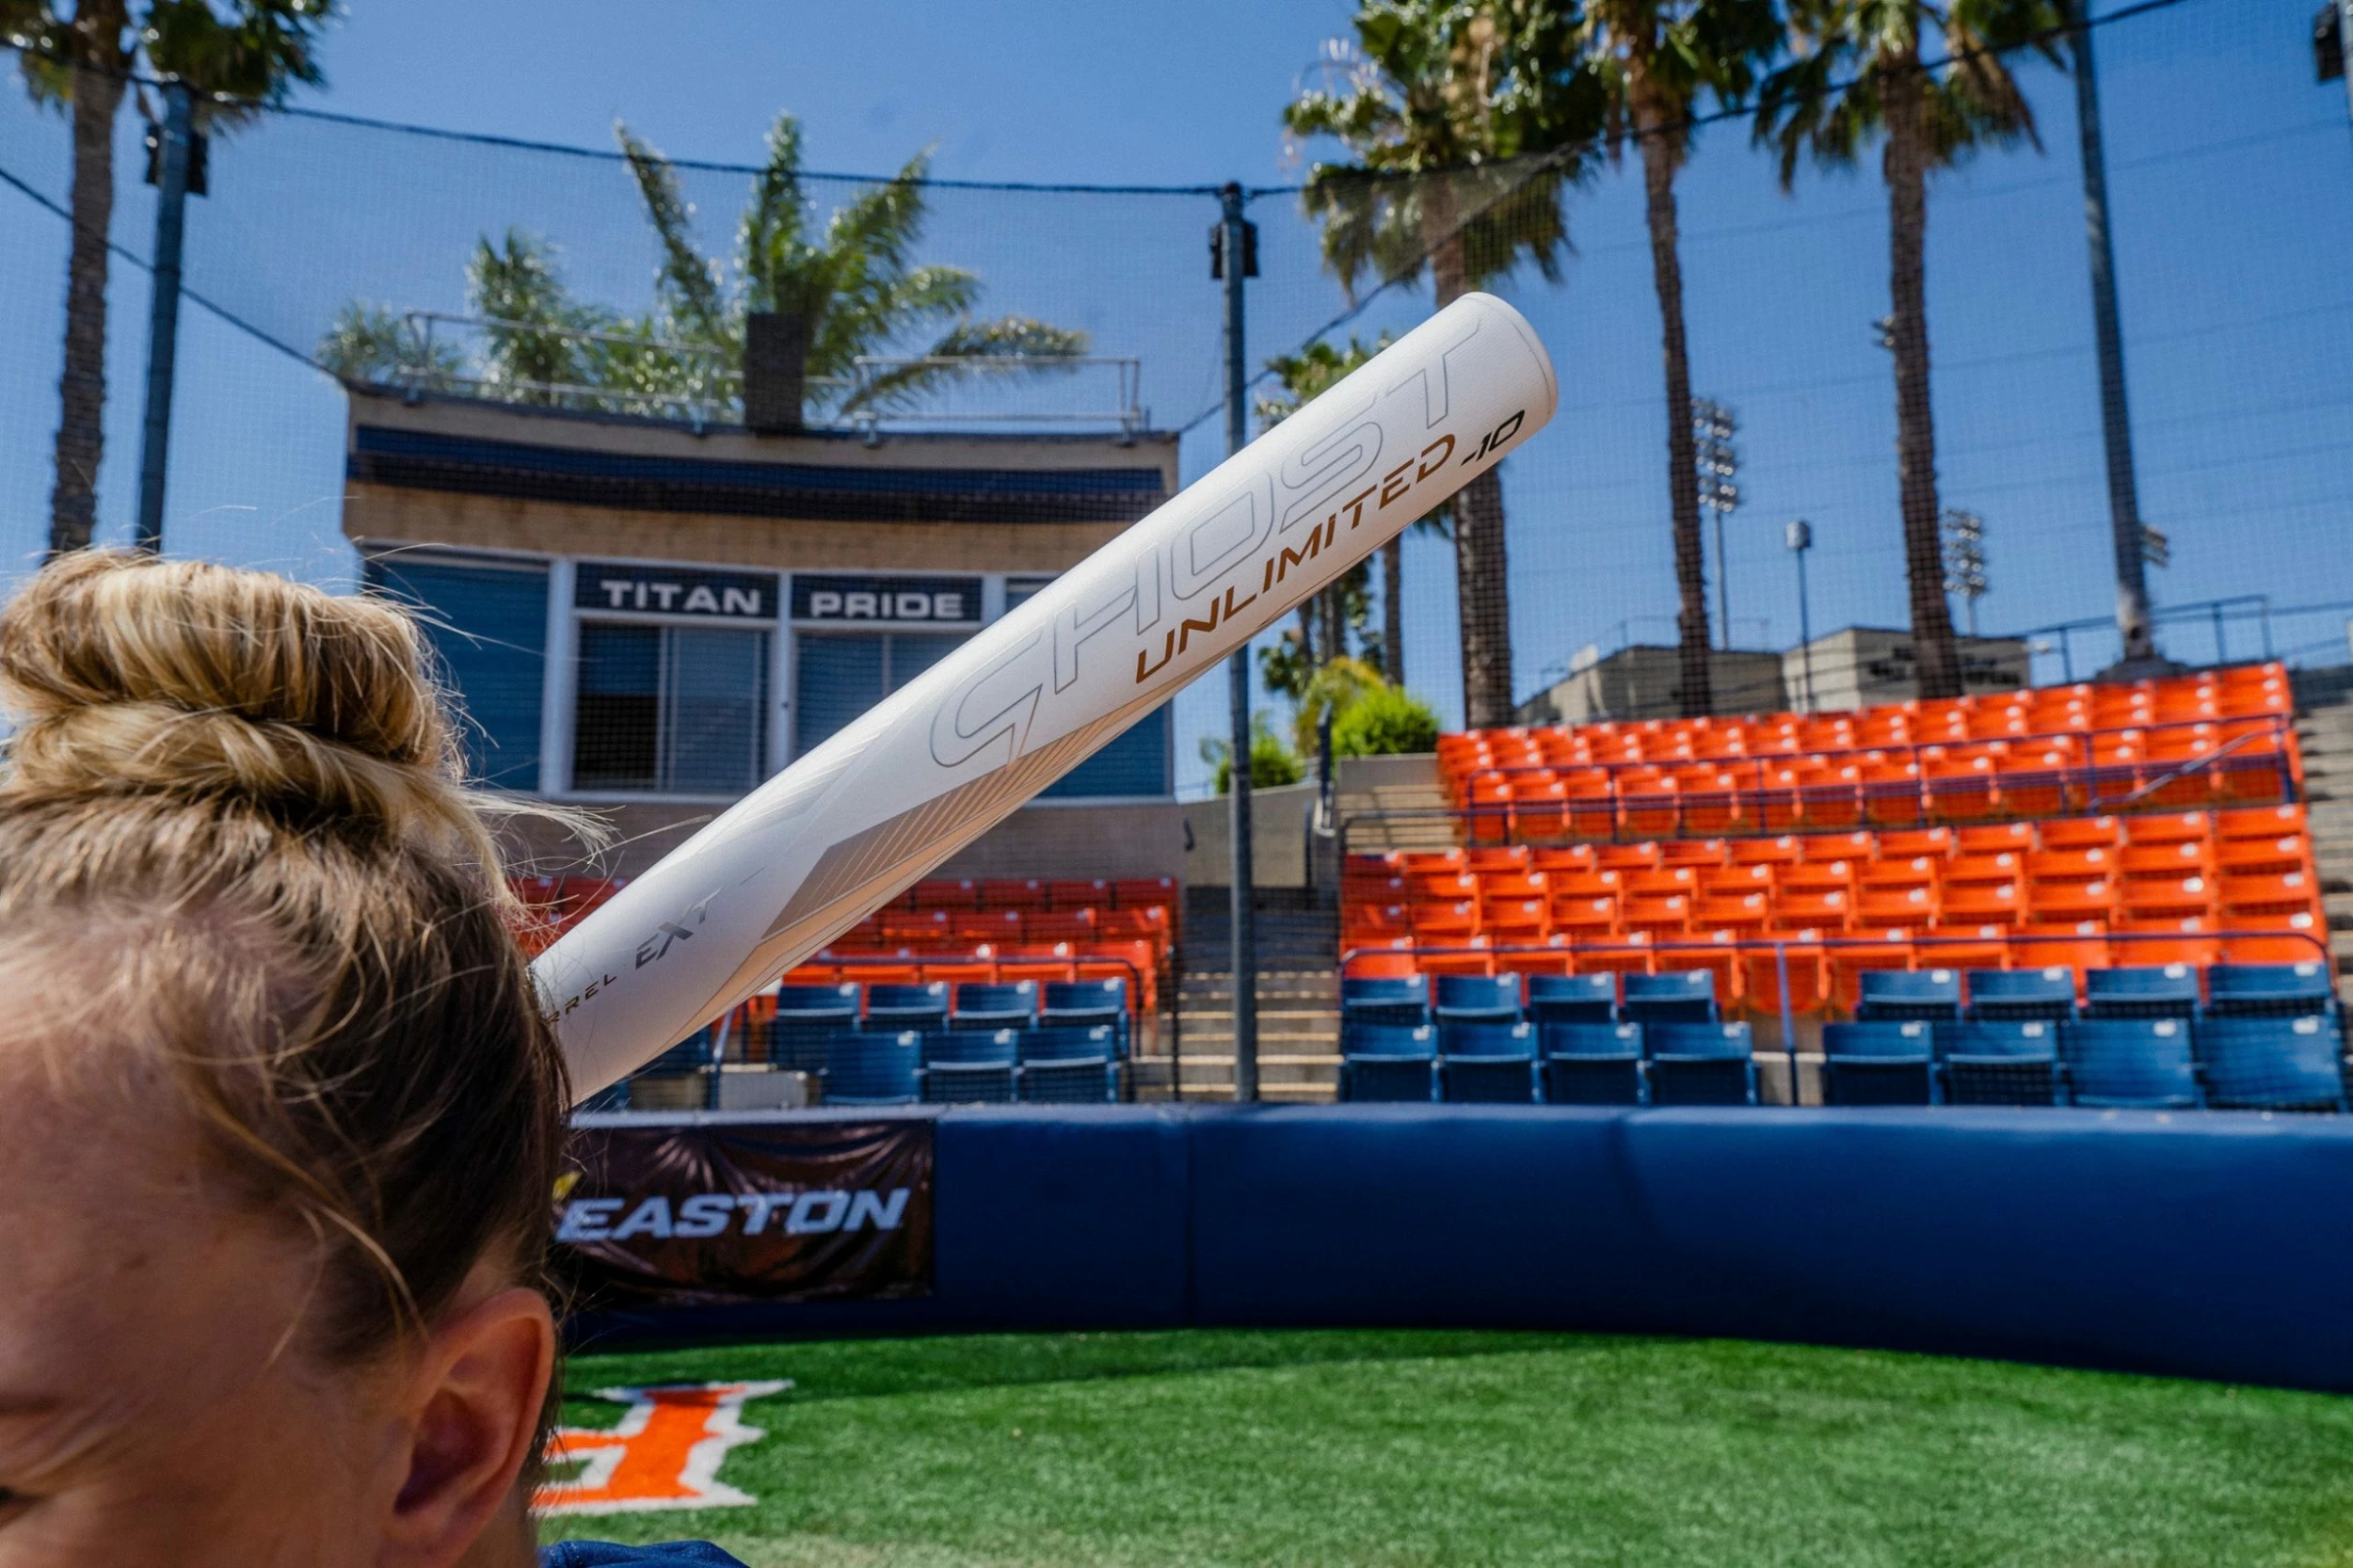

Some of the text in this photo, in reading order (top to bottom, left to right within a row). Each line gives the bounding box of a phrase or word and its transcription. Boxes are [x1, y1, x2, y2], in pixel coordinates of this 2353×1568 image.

[600, 580, 963, 619] TITAN PRIDE
[929, 315, 1481, 770] GHOST
[1136, 409, 1526, 684] UNLIMITED -10
[555, 1187, 910, 1242] EASTON
